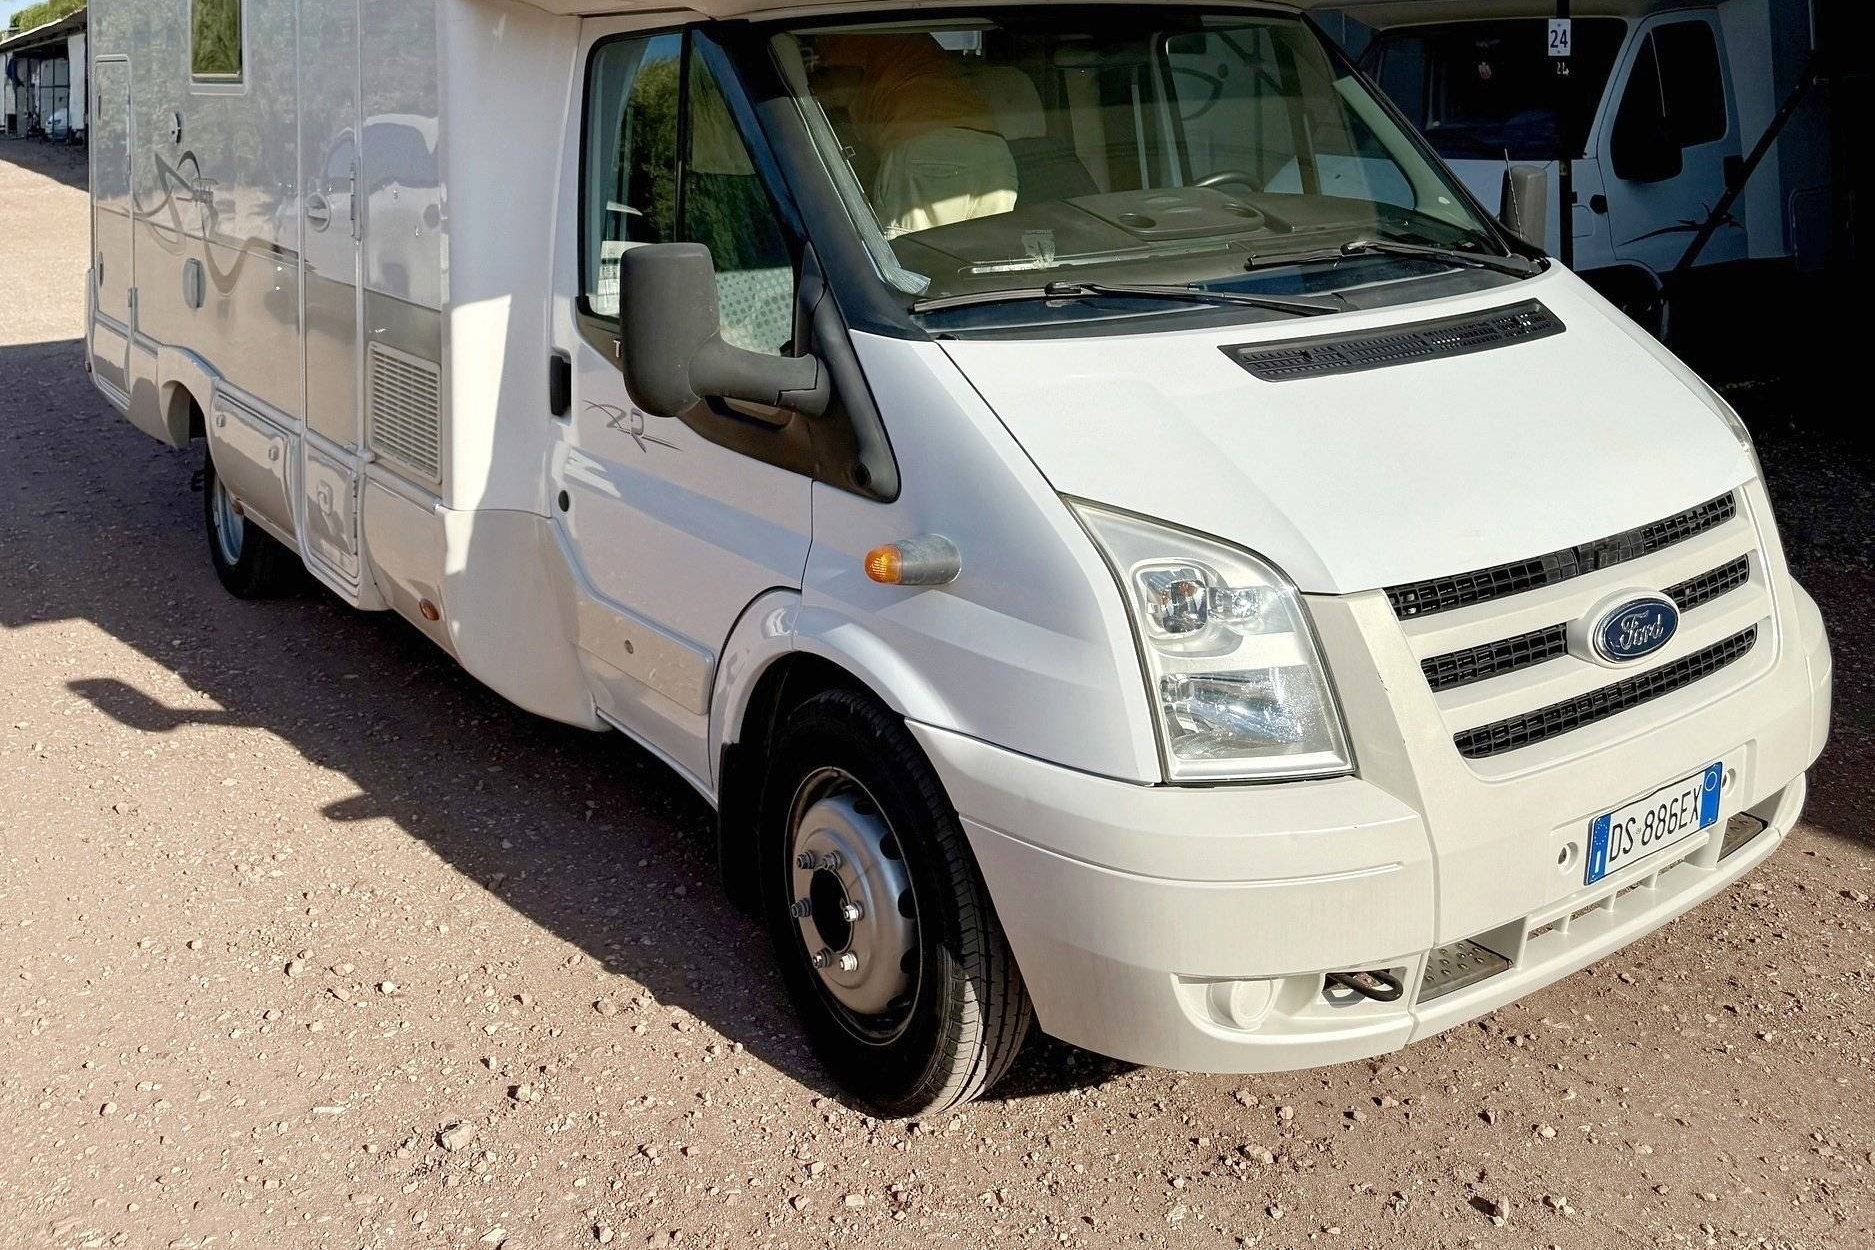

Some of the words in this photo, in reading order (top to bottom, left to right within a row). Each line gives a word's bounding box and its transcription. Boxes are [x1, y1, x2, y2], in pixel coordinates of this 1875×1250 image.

[1550, 29, 1568, 48] 24
[1619, 610, 1664, 650] Ford
[1609, 817, 1636, 863] DS
[1641, 784, 1703, 847] 886EX
